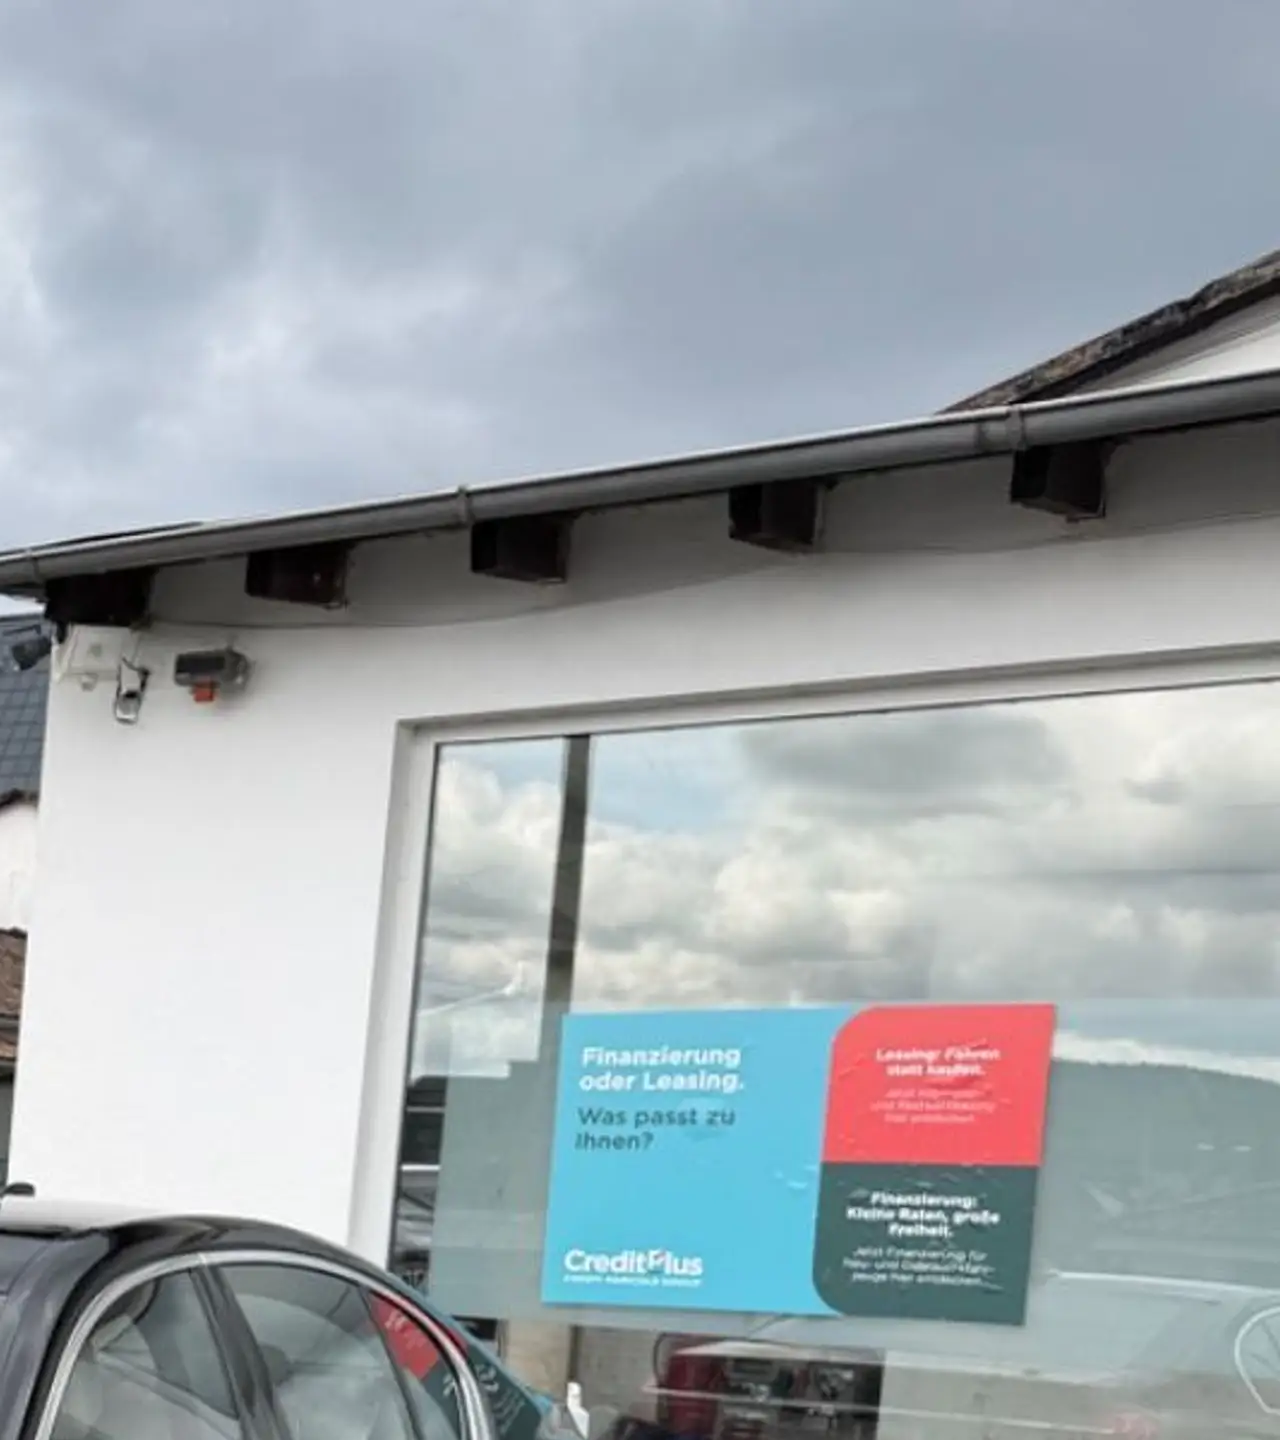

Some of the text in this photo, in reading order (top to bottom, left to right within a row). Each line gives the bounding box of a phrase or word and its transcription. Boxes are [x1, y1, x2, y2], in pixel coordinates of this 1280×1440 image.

[582, 1045, 741, 1068] Finanzierung
[579, 1070, 744, 1093] oder Leasing.
[577, 1107, 735, 1129] Was passt zu
[574, 1131, 654, 1150] Ihnen?
[564, 1247, 703, 1276] CreditPlus
